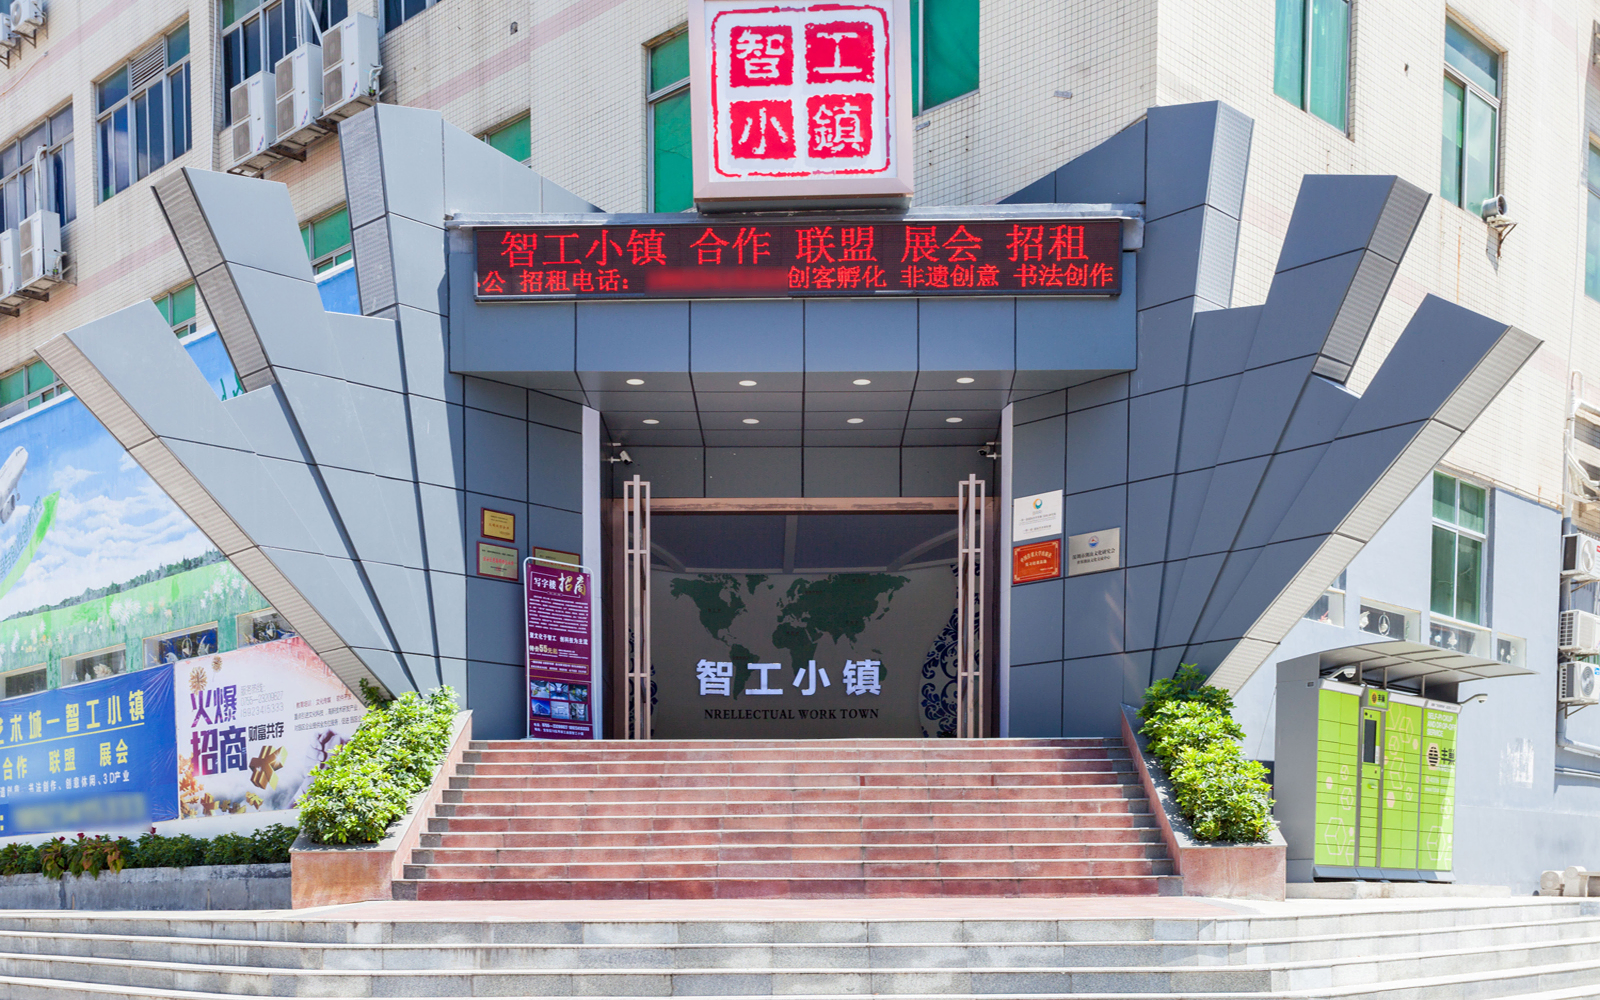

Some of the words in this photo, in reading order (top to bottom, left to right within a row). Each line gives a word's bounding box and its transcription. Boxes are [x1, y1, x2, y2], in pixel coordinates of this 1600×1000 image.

[501, 228, 668, 267] 智工小镇
[690, 227, 771, 265] 合作
[795, 226, 877, 263] 联盟
[901, 225, 982, 263] 展会
[1006, 224, 1089, 262] 招租
[477, 271, 506, 293] 公
[788, 265, 887, 289] 创客孵化
[900, 263, 999, 288] 非遗创意
[1013, 263, 1114, 287] 书法创作
[533, 577, 557, 590] 写字楼
[558, 572, 586, 596] 招商
[696, 659, 881, 696] 智工小镇
[190, 684, 237, 728] 火爆
[704, 709, 794, 720] NRELLECTUAL
[798, 709, 836, 719] WORK
[840, 708, 879, 719] TOWN
[248, 721, 284, 742] 财富共存
[3, 755, 28, 780] 合作
[48, 748, 76, 774] 联盟
[99, 738, 128, 767] 展会
[190, 725, 248, 777] 招商
